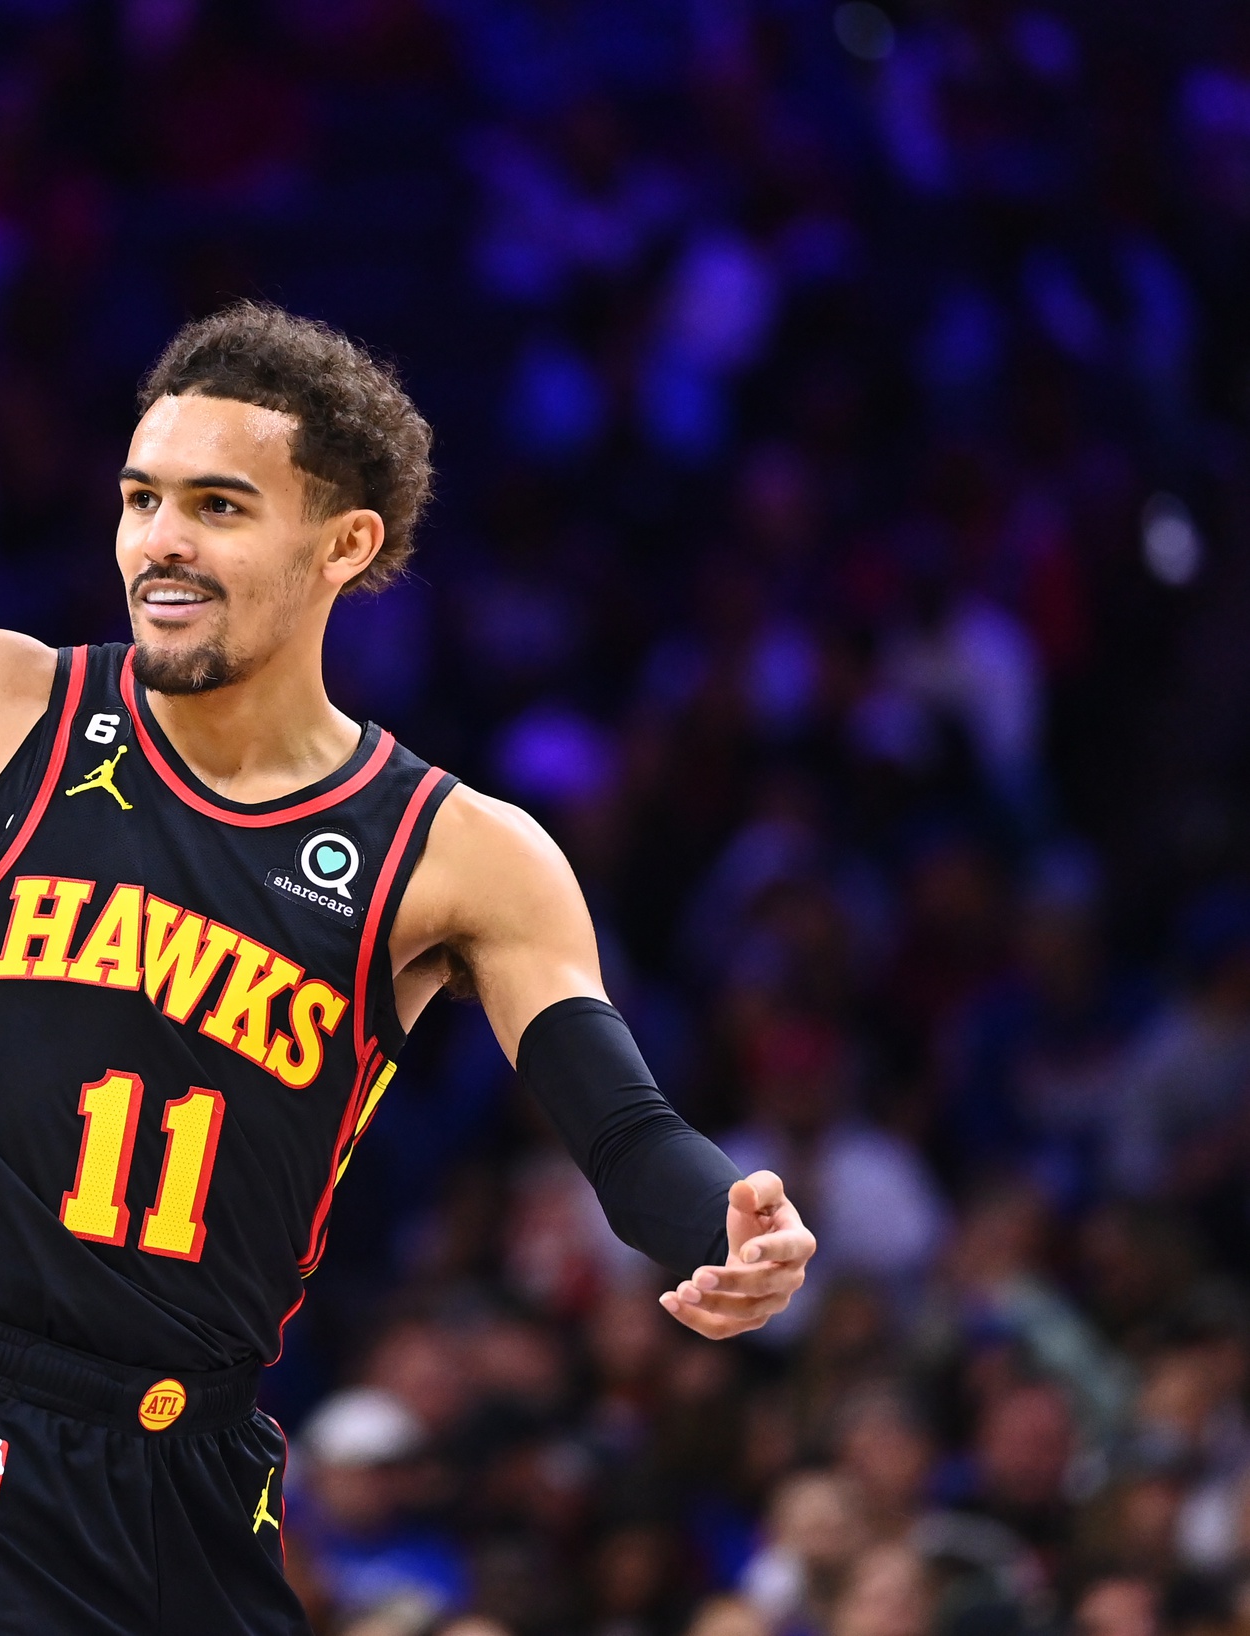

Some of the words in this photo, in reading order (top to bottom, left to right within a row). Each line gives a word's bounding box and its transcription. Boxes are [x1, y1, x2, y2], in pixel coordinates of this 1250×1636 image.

[84, 713, 121, 745] 6
[273, 876, 354, 917] sharecare
[58, 1068, 227, 1263] 11
[144, 1395, 179, 1416] ATL
